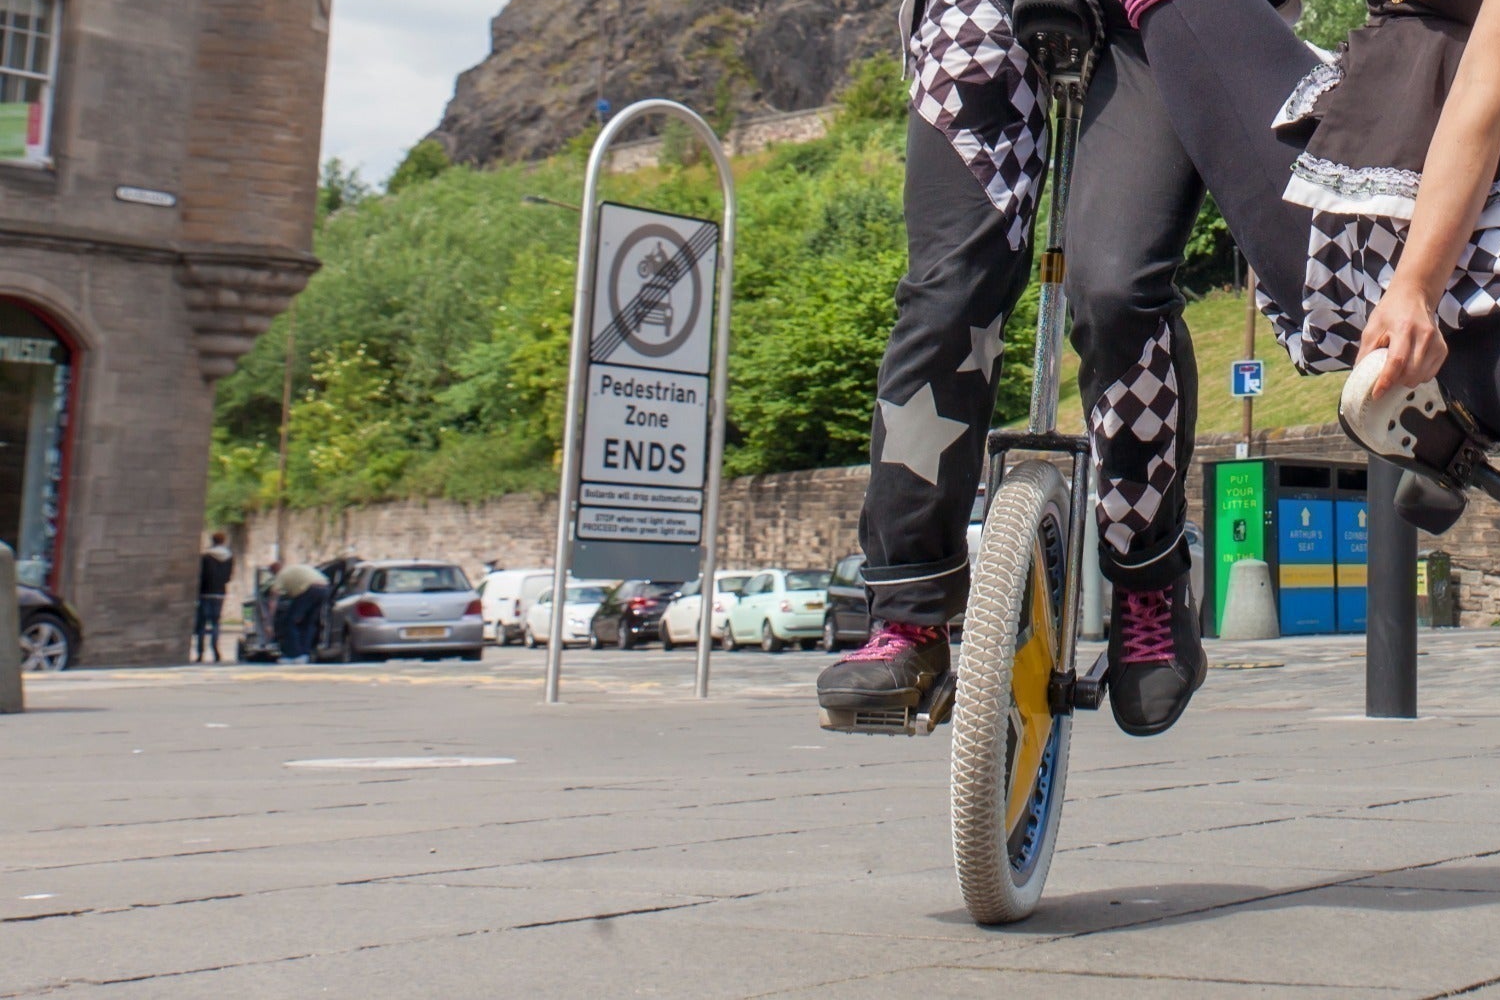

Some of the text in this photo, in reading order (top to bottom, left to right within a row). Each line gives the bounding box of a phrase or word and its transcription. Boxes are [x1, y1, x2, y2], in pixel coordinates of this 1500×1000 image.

[601, 374, 696, 404] Pedestrian
[625, 405, 668, 428] Zone
[603, 437, 687, 475] ENDS
[1230, 474, 1249, 484] PUT
[1226, 487, 1254, 497] YOUR
[1222, 499, 1257, 511] LITTER
[1290, 529, 1323, 540] ARTHUR'S
[1298, 542, 1315, 552] SEAT
[1223, 553, 1234, 563] IN
